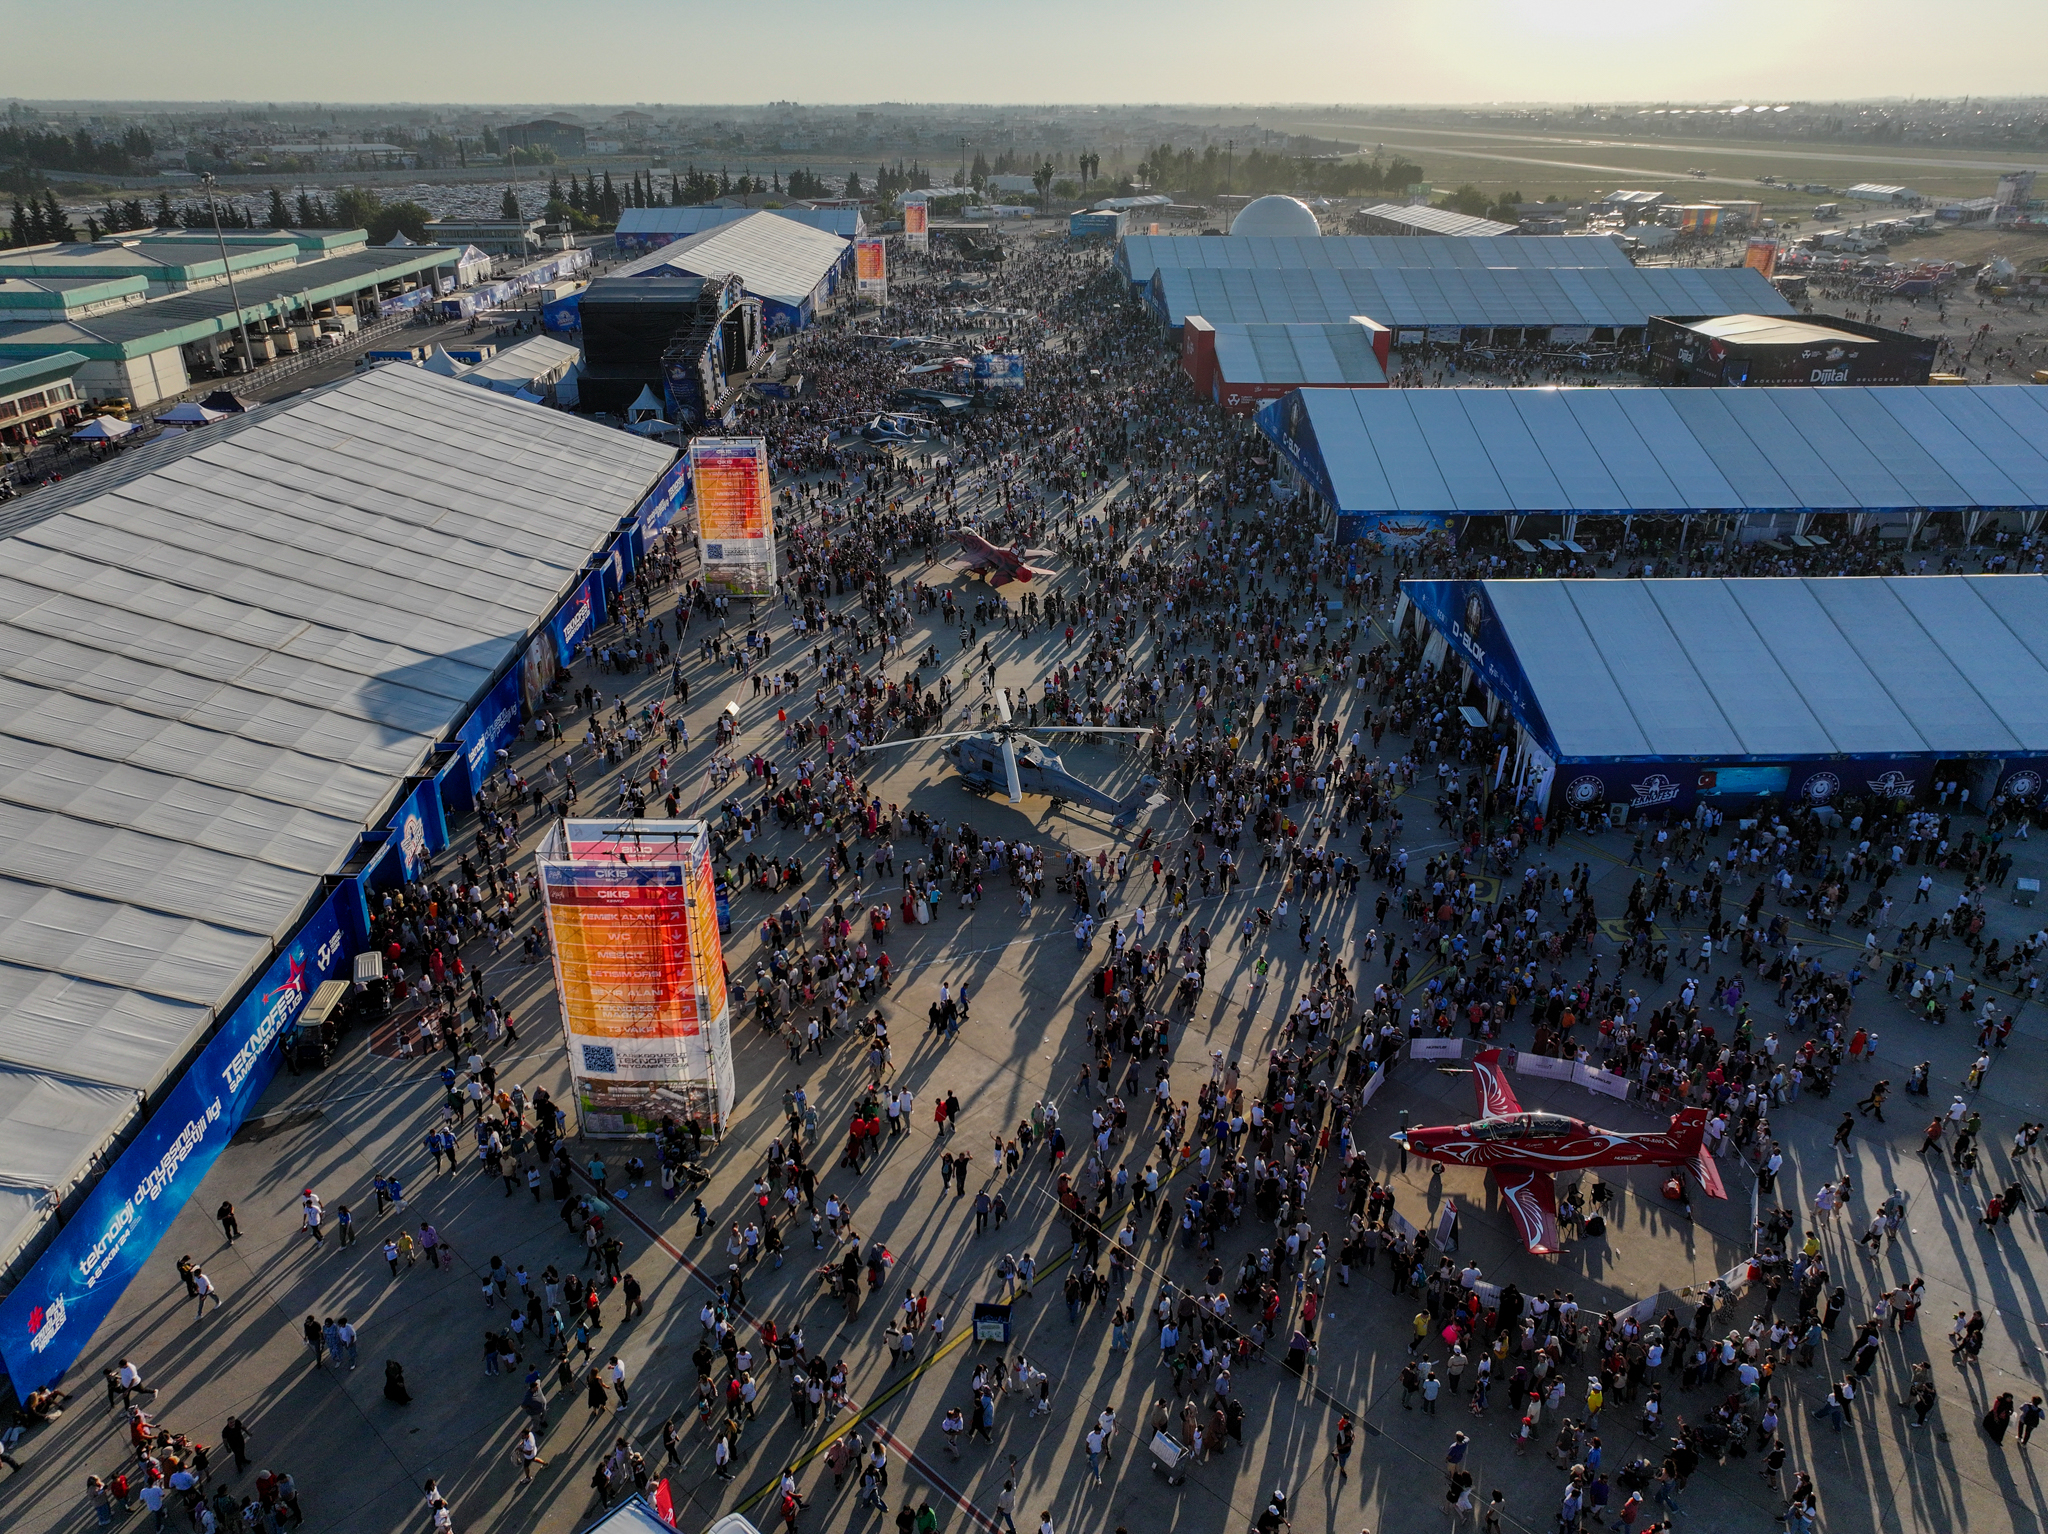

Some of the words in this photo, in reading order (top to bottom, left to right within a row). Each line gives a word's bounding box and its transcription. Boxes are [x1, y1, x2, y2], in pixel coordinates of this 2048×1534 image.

[1810, 368, 1849, 385] Dijital
[597, 890, 630, 899] ÇIKIŞ
[595, 1004, 661, 1012] TEKNOFEST
[222, 974, 301, 1084] TEKNOFEST
[206, 1096, 222, 1124] ligi
[134, 1120, 196, 1205] dünyasının
[79, 1198, 135, 1276] teknoloji
